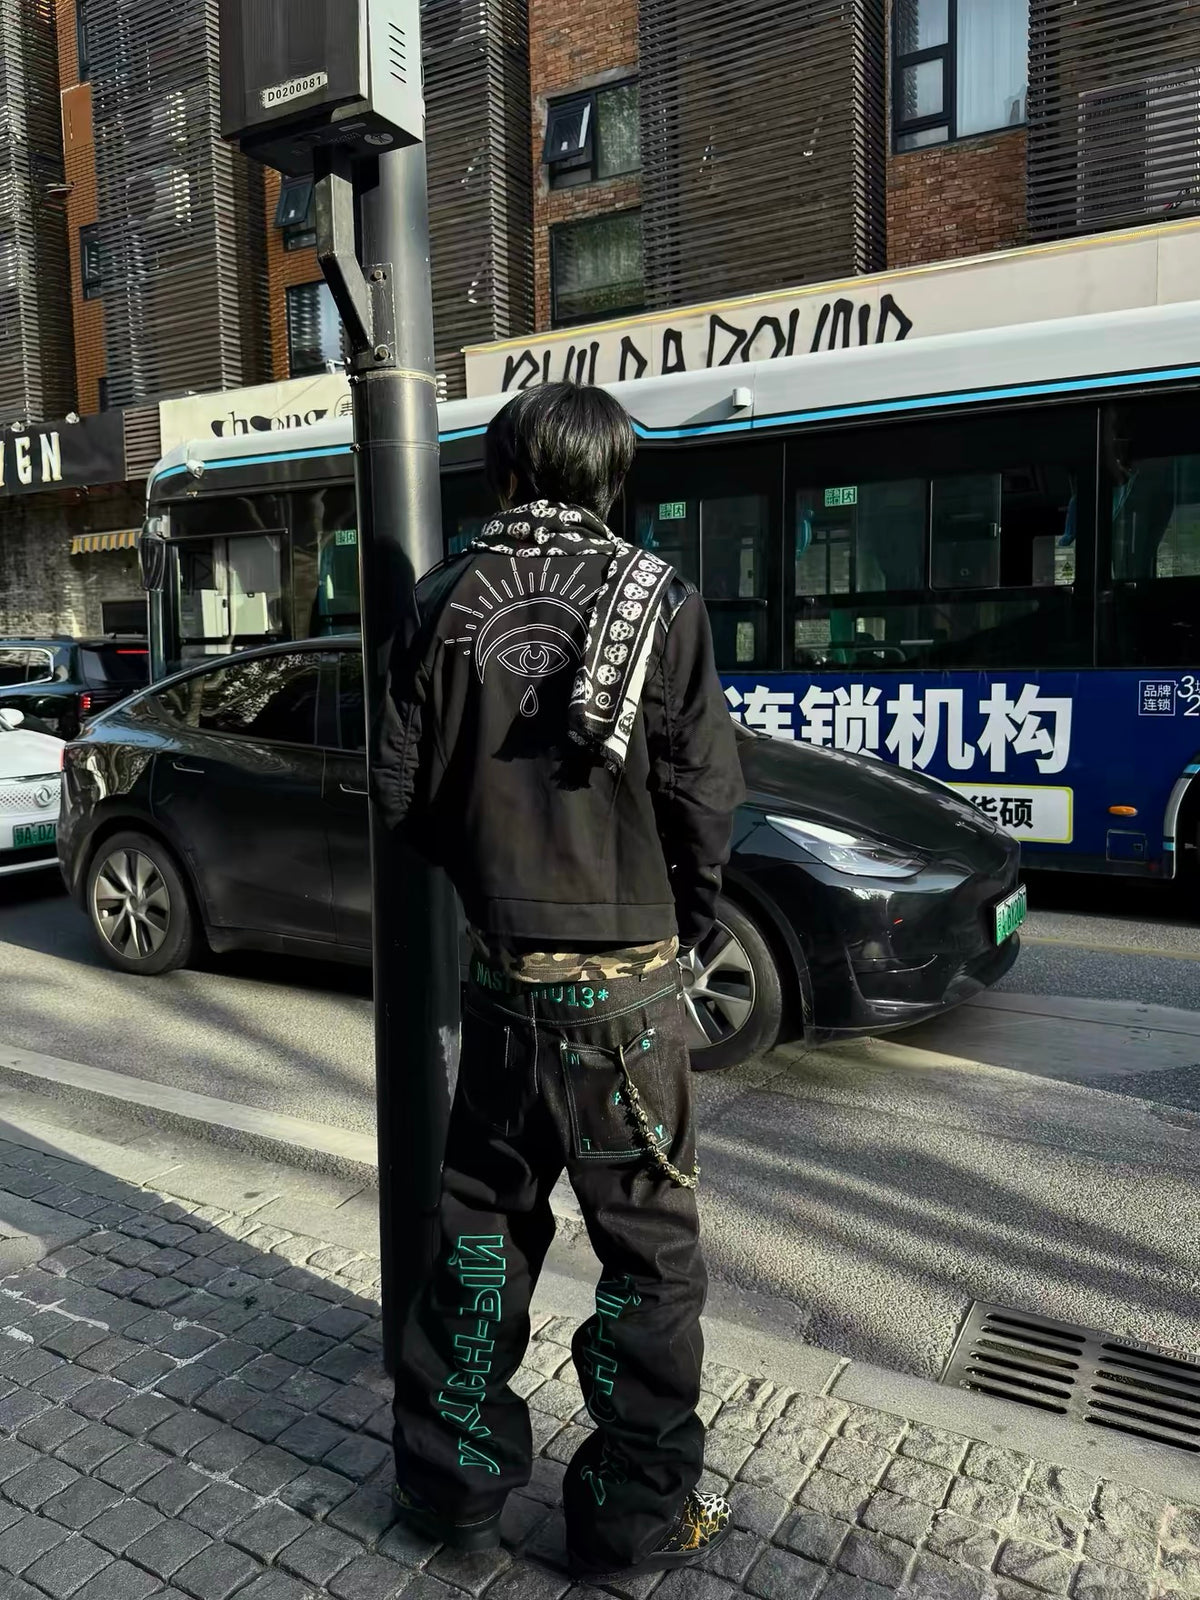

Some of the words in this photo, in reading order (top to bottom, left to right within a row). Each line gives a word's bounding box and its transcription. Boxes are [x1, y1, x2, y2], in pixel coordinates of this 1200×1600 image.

[267, 76, 321, 101] D0200081
[1143, 684, 1171, 698] 品牌
[1143, 698, 1171, 711] 连锁
[724, 683, 1073, 775] 连锁机构
[970, 795, 1034, 829] 华硕
